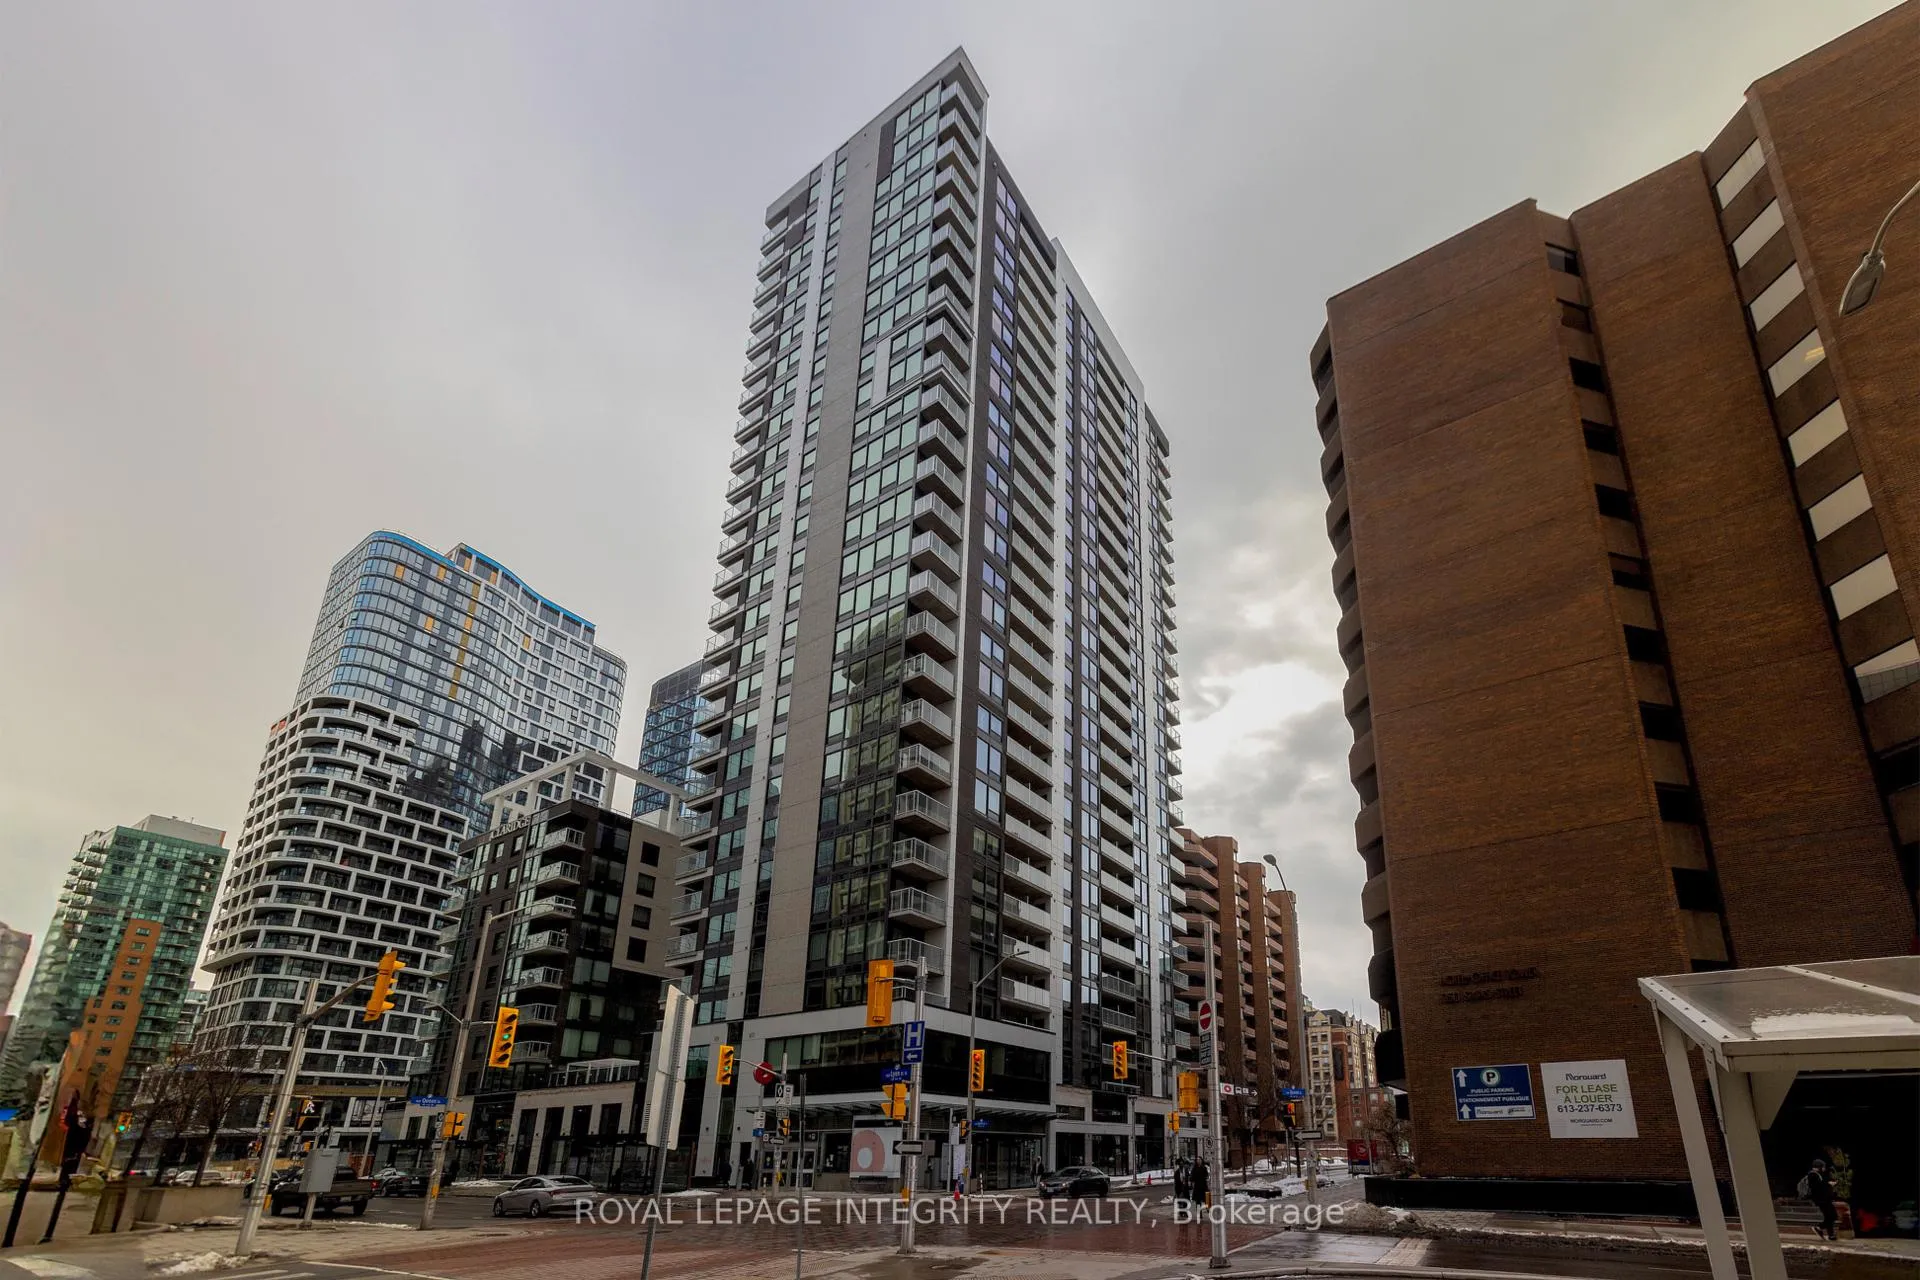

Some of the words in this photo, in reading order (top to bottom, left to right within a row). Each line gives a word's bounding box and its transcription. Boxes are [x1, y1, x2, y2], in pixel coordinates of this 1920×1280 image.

[906, 1023, 922, 1047] H
[1485, 1071, 1496, 1083] P
[1556, 1085, 1579, 1094] FOR
[1581, 1083, 1618, 1094] LEASE
[1574, 1094, 1613, 1104] LOUER
[1557, 1103, 1623, 1113] 613-237-6373
